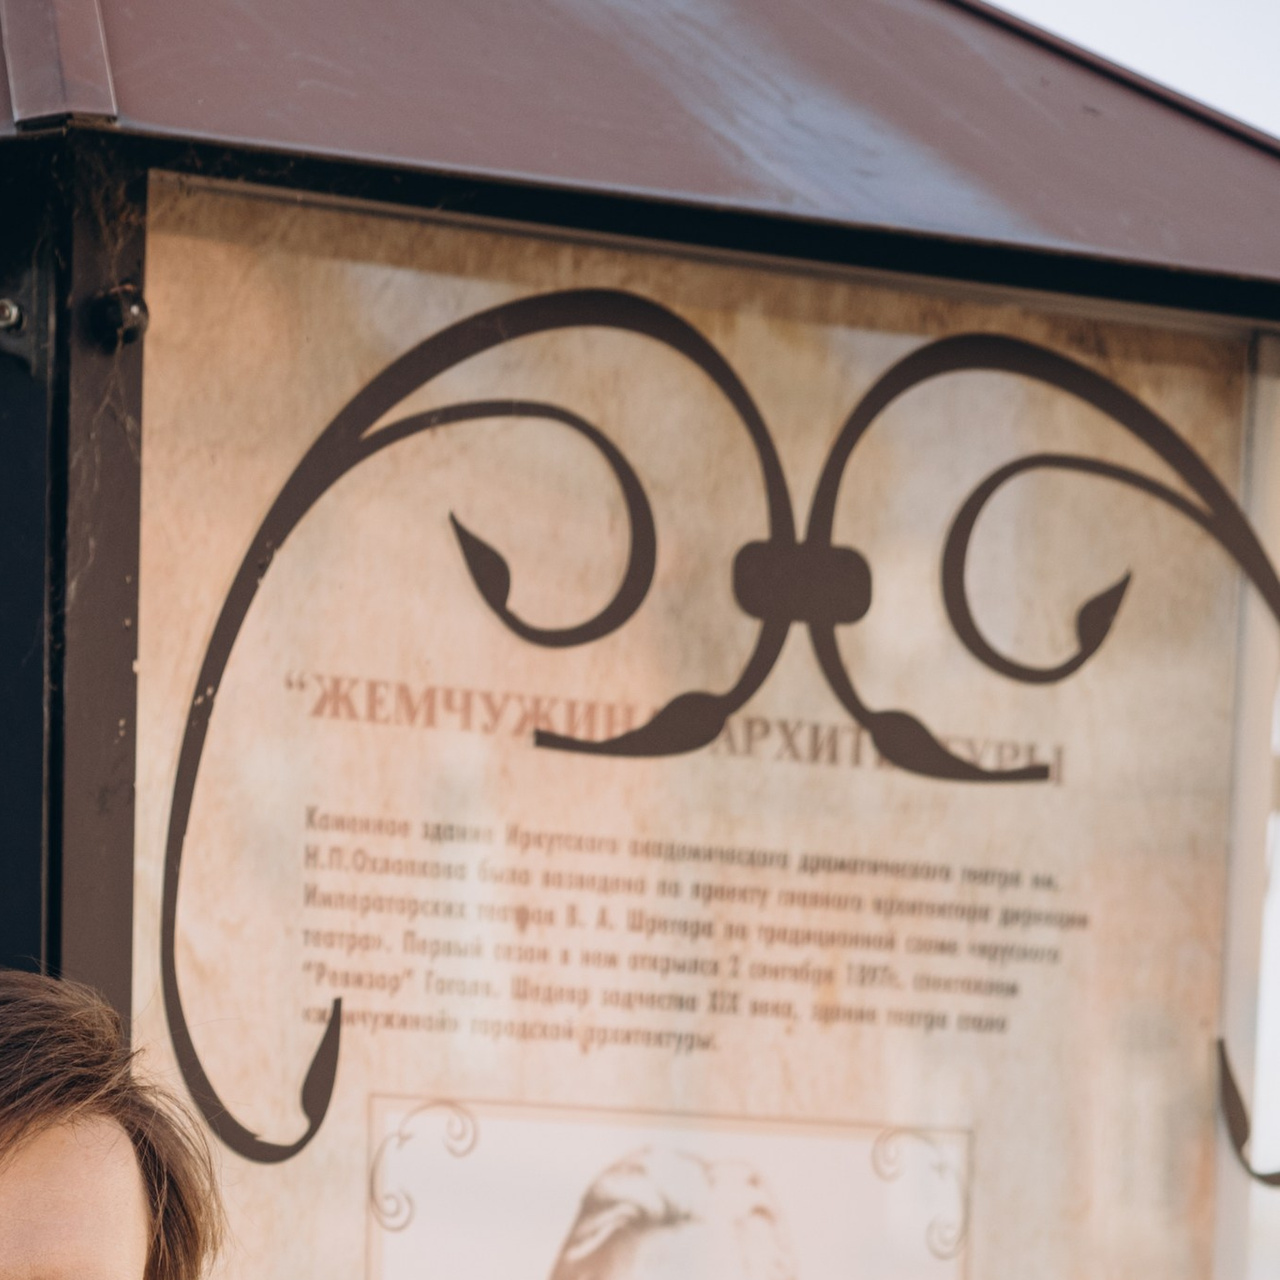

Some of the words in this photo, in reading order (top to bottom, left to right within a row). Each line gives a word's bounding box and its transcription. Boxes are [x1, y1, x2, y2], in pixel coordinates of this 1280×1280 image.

[284, 670, 664, 741] “ЖЕМЧУЖИН
[305, 806, 410, 839] Каменное
[505, 823, 618, 856] Иркутского
[304, 844, 468, 882] Н.П.Охлопкова
[303, 882, 467, 921] Императорских
[402, 930, 483, 963] Первый
[728, 956, 740, 979] 2
[510, 976, 590, 1009] Шедевр
[707, 990, 742, 1016] XIX
